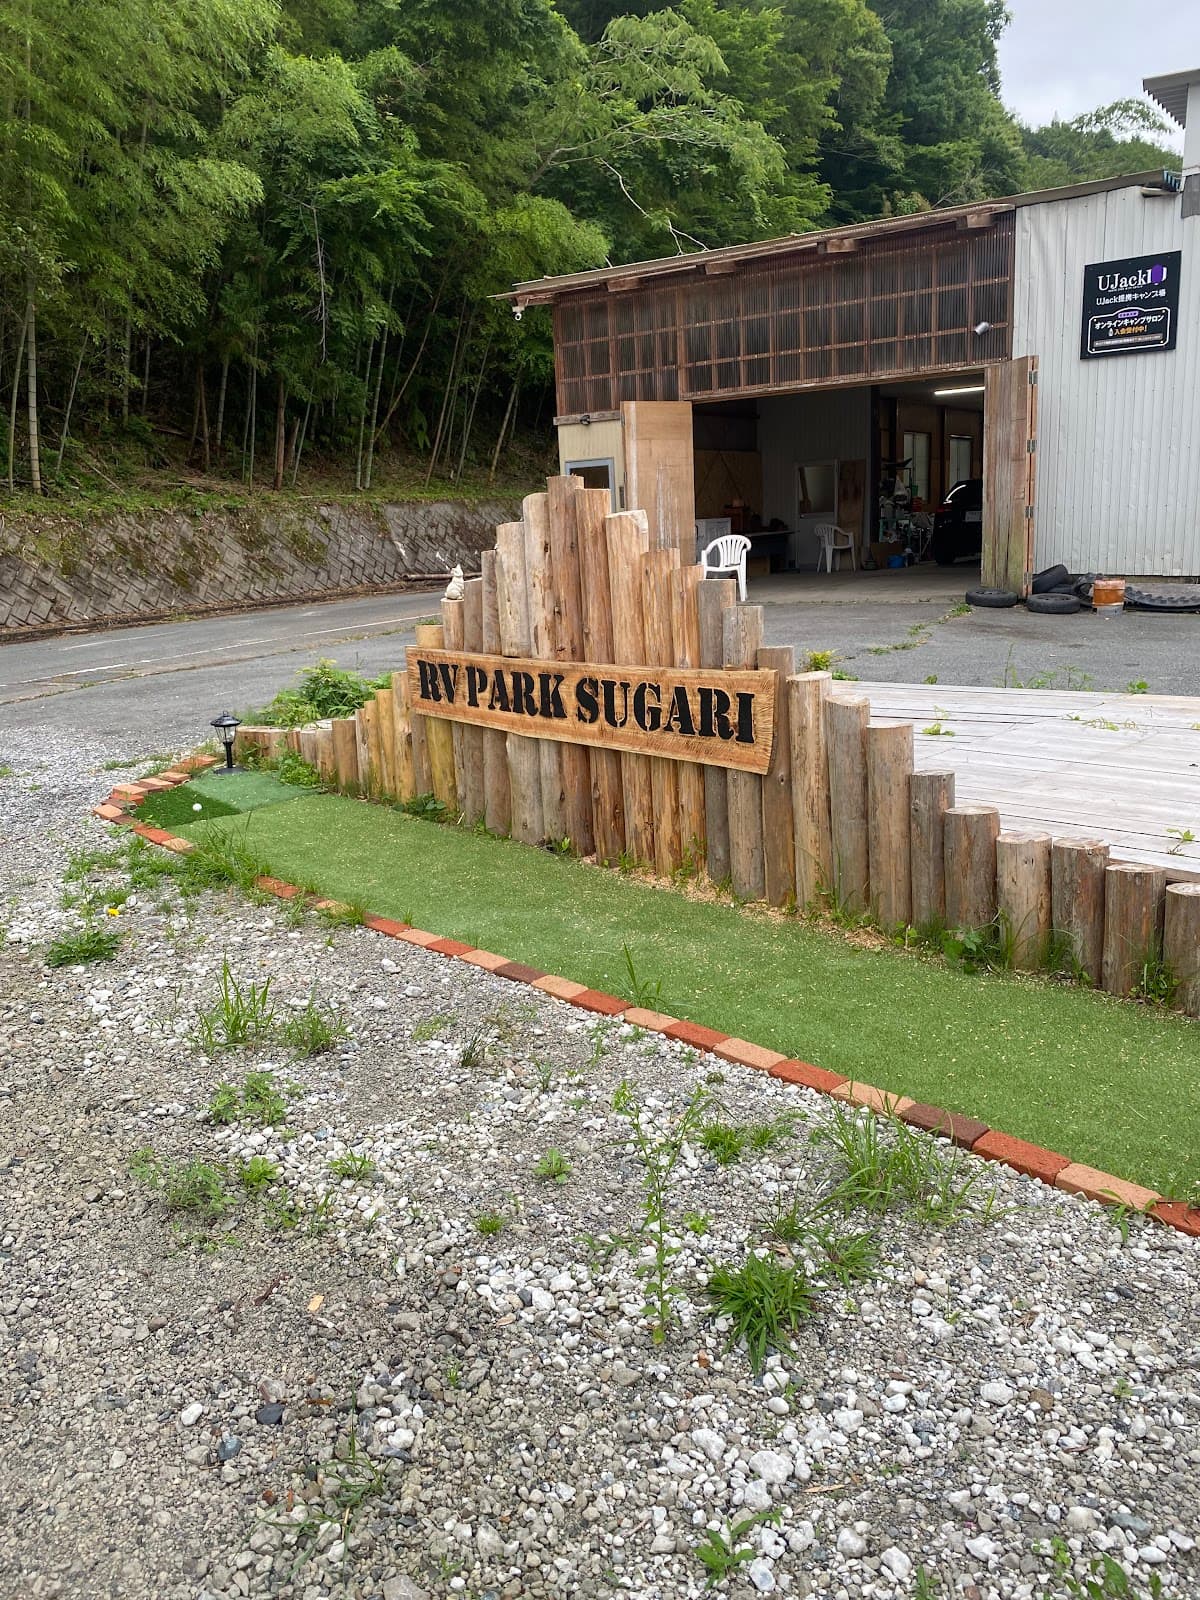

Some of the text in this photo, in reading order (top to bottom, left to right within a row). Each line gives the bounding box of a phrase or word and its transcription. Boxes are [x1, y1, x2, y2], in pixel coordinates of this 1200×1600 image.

[1098, 270, 1146, 291] UJack
[417, 660, 755, 744] RV PARK SUGARI
